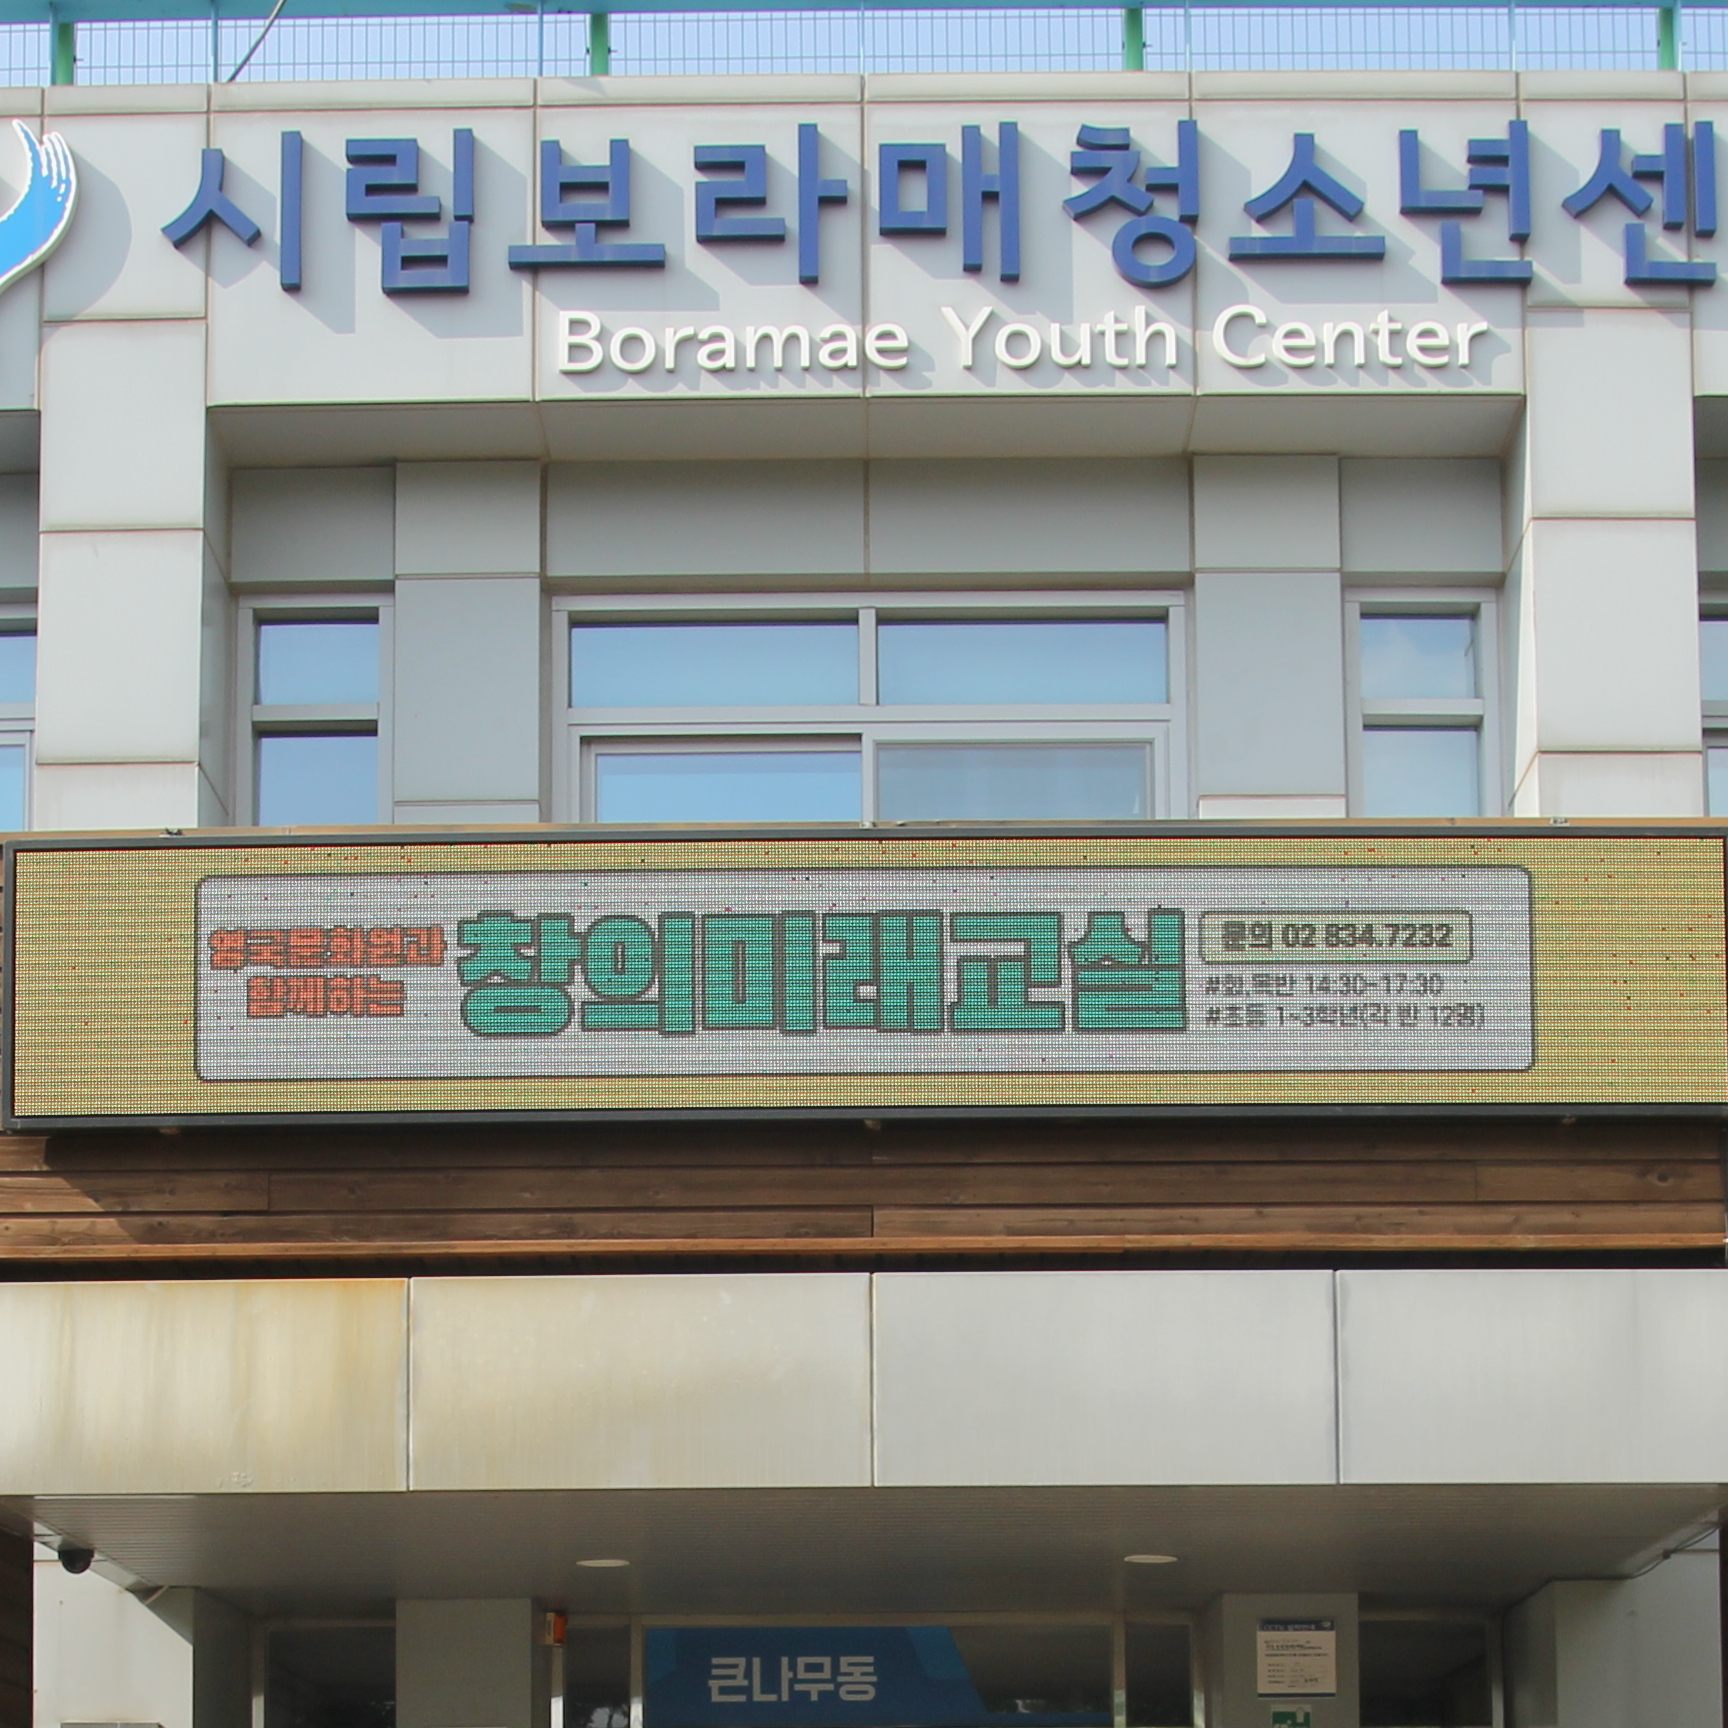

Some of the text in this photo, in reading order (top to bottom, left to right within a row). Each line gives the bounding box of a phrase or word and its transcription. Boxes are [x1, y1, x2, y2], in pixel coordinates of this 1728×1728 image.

[556, 303, 1489, 373] Boramae Youth Center
[1222, 920, 1453, 951] 문의 02 834.7232
[456, 908, 1188, 1036] 창의미래교실
[246, 975, 406, 1018] 함께하는
[708, 1655, 878, 1703] 큰나무동
